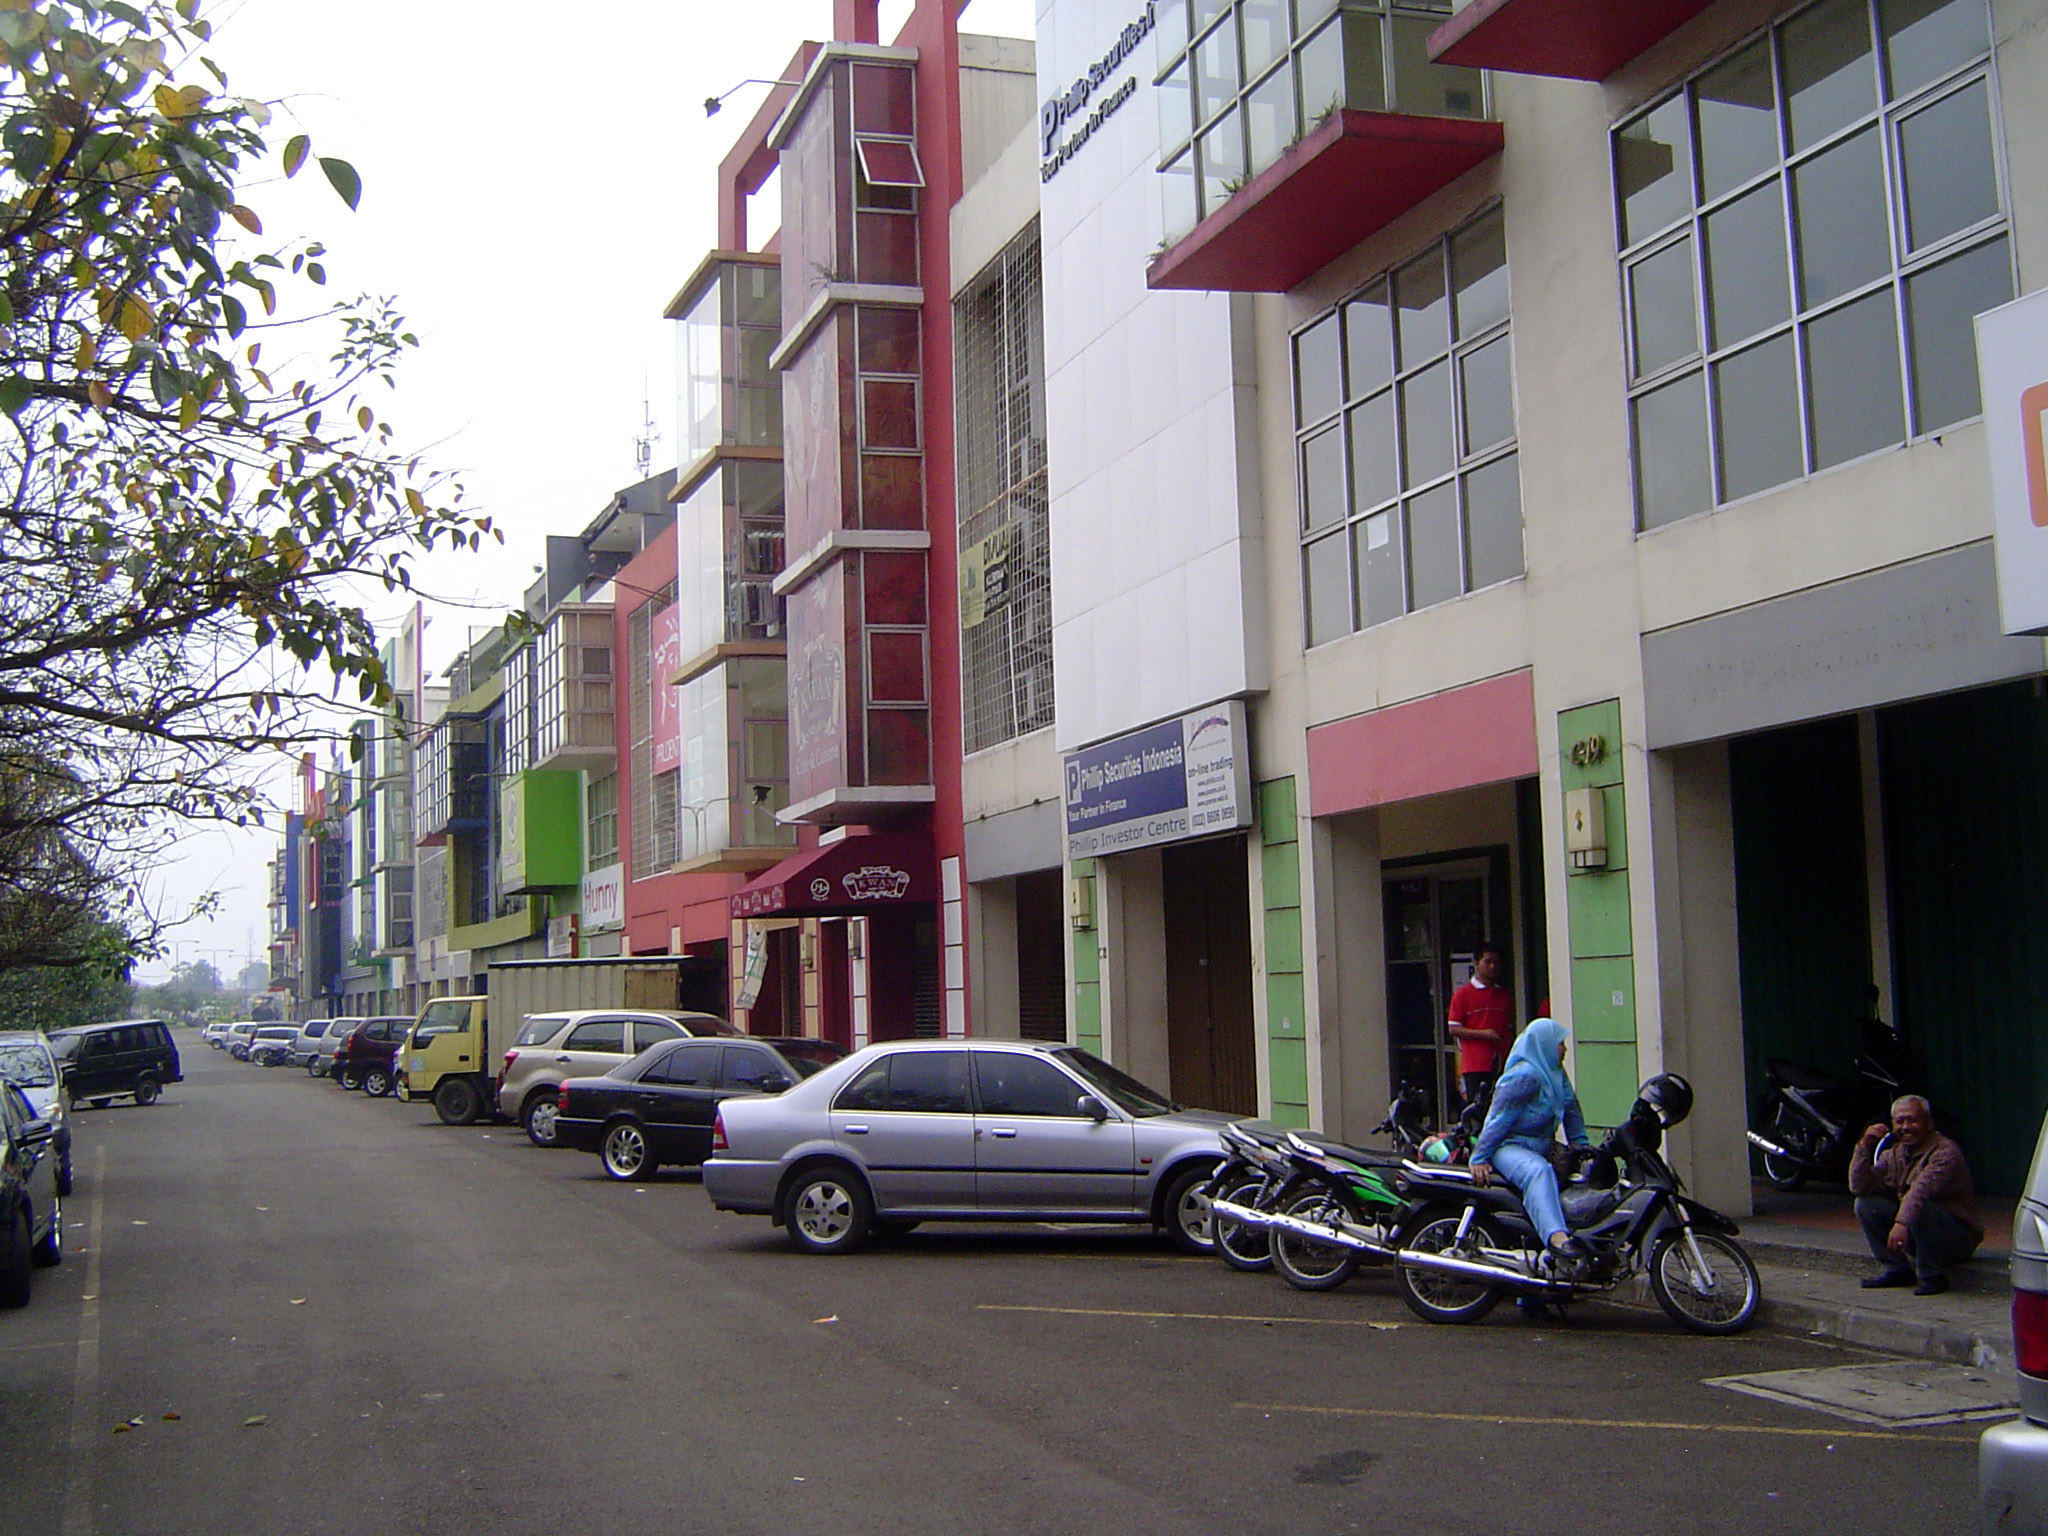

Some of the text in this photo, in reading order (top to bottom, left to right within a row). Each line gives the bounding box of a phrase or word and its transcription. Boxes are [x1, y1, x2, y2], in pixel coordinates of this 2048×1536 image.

[1058, 78, 1091, 125] Phillip
[1088, 15, 1149, 91] Securities
[1081, 765, 1104, 792] Phillip
[1104, 754, 1142, 784] Securities
[1142, 741, 1183, 773] Indonesia
[1069, 818, 1187, 854] Phillip Investor Centre
